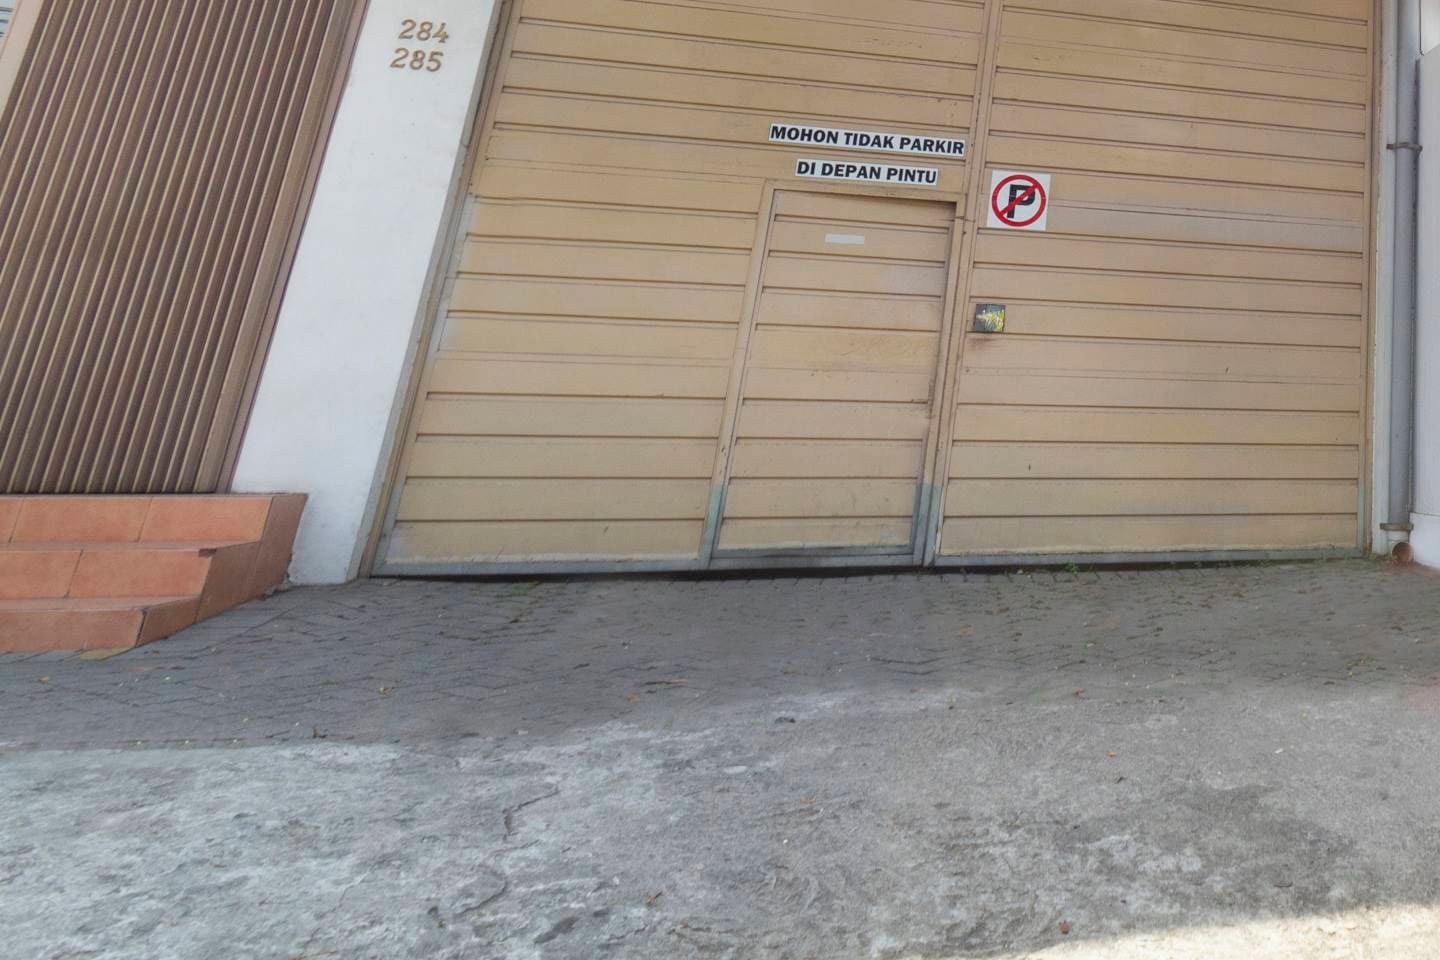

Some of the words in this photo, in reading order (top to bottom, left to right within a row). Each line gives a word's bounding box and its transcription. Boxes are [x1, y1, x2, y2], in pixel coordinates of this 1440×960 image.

[398, 19, 450, 44] 284
[390, 47, 444, 72] 285
[770, 125, 839, 144] MOHON
[844, 132, 894, 149] TIDAK
[900, 137, 965, 155] PARKIR
[797, 161, 816, 176] DI
[821, 163, 881, 180] DEPAN
[886, 168, 937, 184] PINTU
[1007, 184, 1036, 219] P
